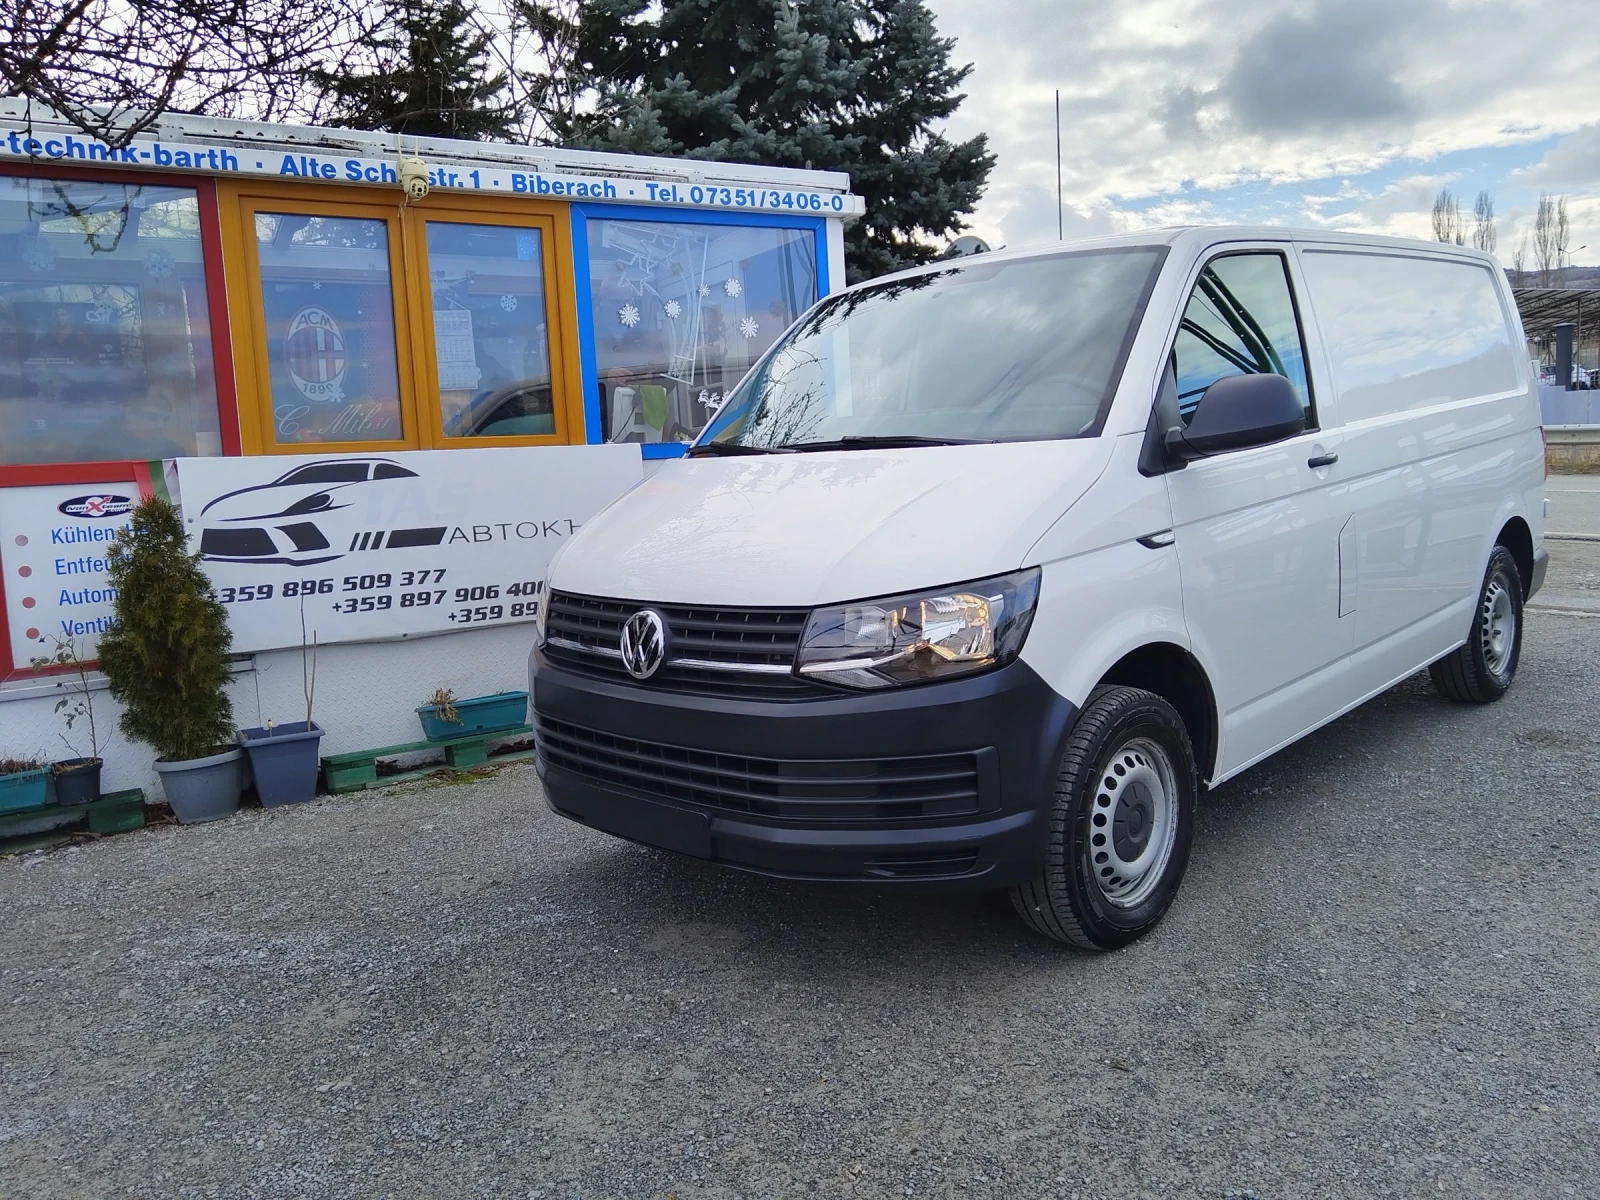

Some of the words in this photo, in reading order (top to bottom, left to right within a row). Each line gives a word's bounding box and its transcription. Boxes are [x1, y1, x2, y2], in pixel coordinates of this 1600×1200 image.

[280, 155, 337, 179] Alte
[345, 159, 464, 188] Schstr.
[511, 173, 617, 198] Biberach
[646, 183, 684, 203] Tel.
[690, 186, 844, 212] 07351/3406-0
[296, 311, 334, 331] ACM
[302, 383, 334, 395] 1899
[51, 526, 115, 544] Kühlen
[448, 519, 582, 545] АВТОКЪ
[282, 579, 334, 598] 896
[342, 573, 392, 592] 509
[400, 568, 447, 587] 377
[59, 588, 119, 606] Autom
[332, 595, 392, 614] +359
[400, 590, 447, 608] 897
[454, 585, 499, 602] 906
[448, 605, 503, 623] +359
[511, 601, 538, 617] 89
[61, 616, 121, 636] Ventil
